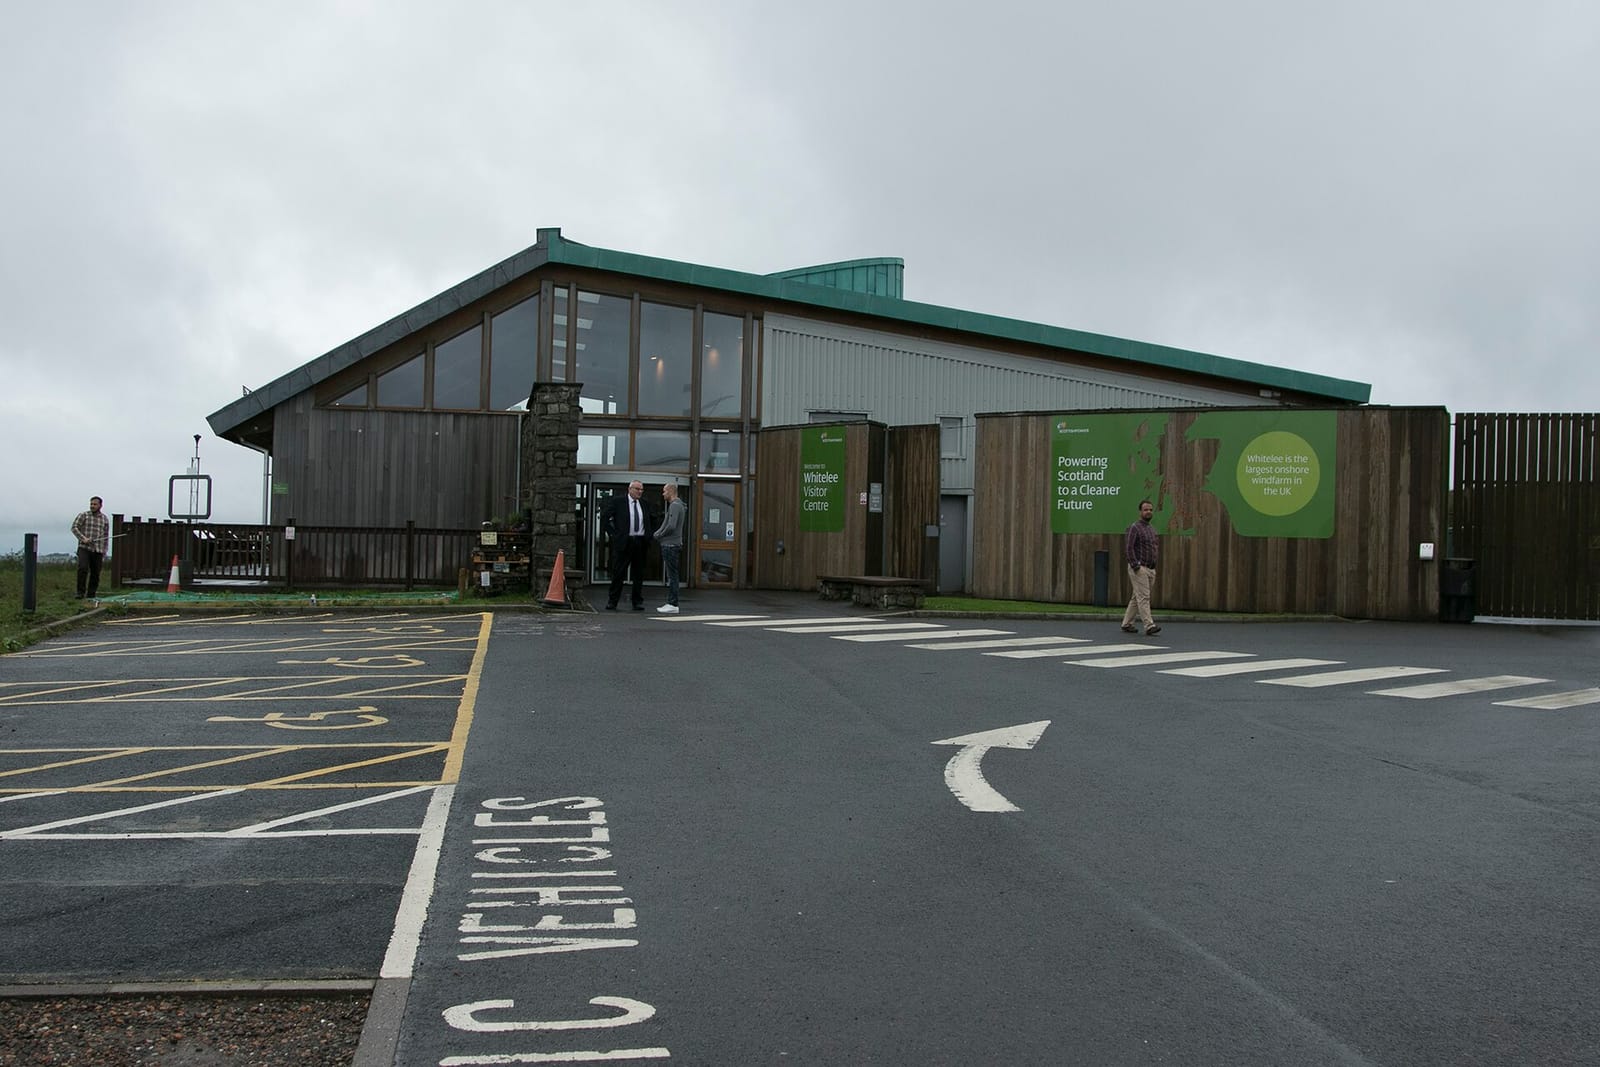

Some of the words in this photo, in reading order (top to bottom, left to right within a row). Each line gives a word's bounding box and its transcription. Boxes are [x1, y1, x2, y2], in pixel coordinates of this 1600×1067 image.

[1058, 456, 1108, 469] Powering
[1247, 454, 1283, 463] Whitelee
[1285, 454, 1292, 463] is
[1294, 454, 1308, 463] the
[1057, 470, 1104, 481] Scotland
[1245, 465, 1273, 475] largest
[1274, 465, 1309, 474] onshore
[803, 471, 839, 483] Whitelee
[1252, 476, 1292, 485] windfarm
[1293, 476, 1302, 485] in
[803, 485, 828, 497] Visitor
[1058, 485, 1070, 495] to
[1071, 487, 1078, 495] a
[1079, 484, 1121, 495] Cleaner
[1263, 487, 1278, 496] the
[1279, 487, 1292, 496] UK
[803, 499, 829, 511] Centre
[1057, 499, 1093, 510] Future
[457, 796, 640, 961] VEHICLES
